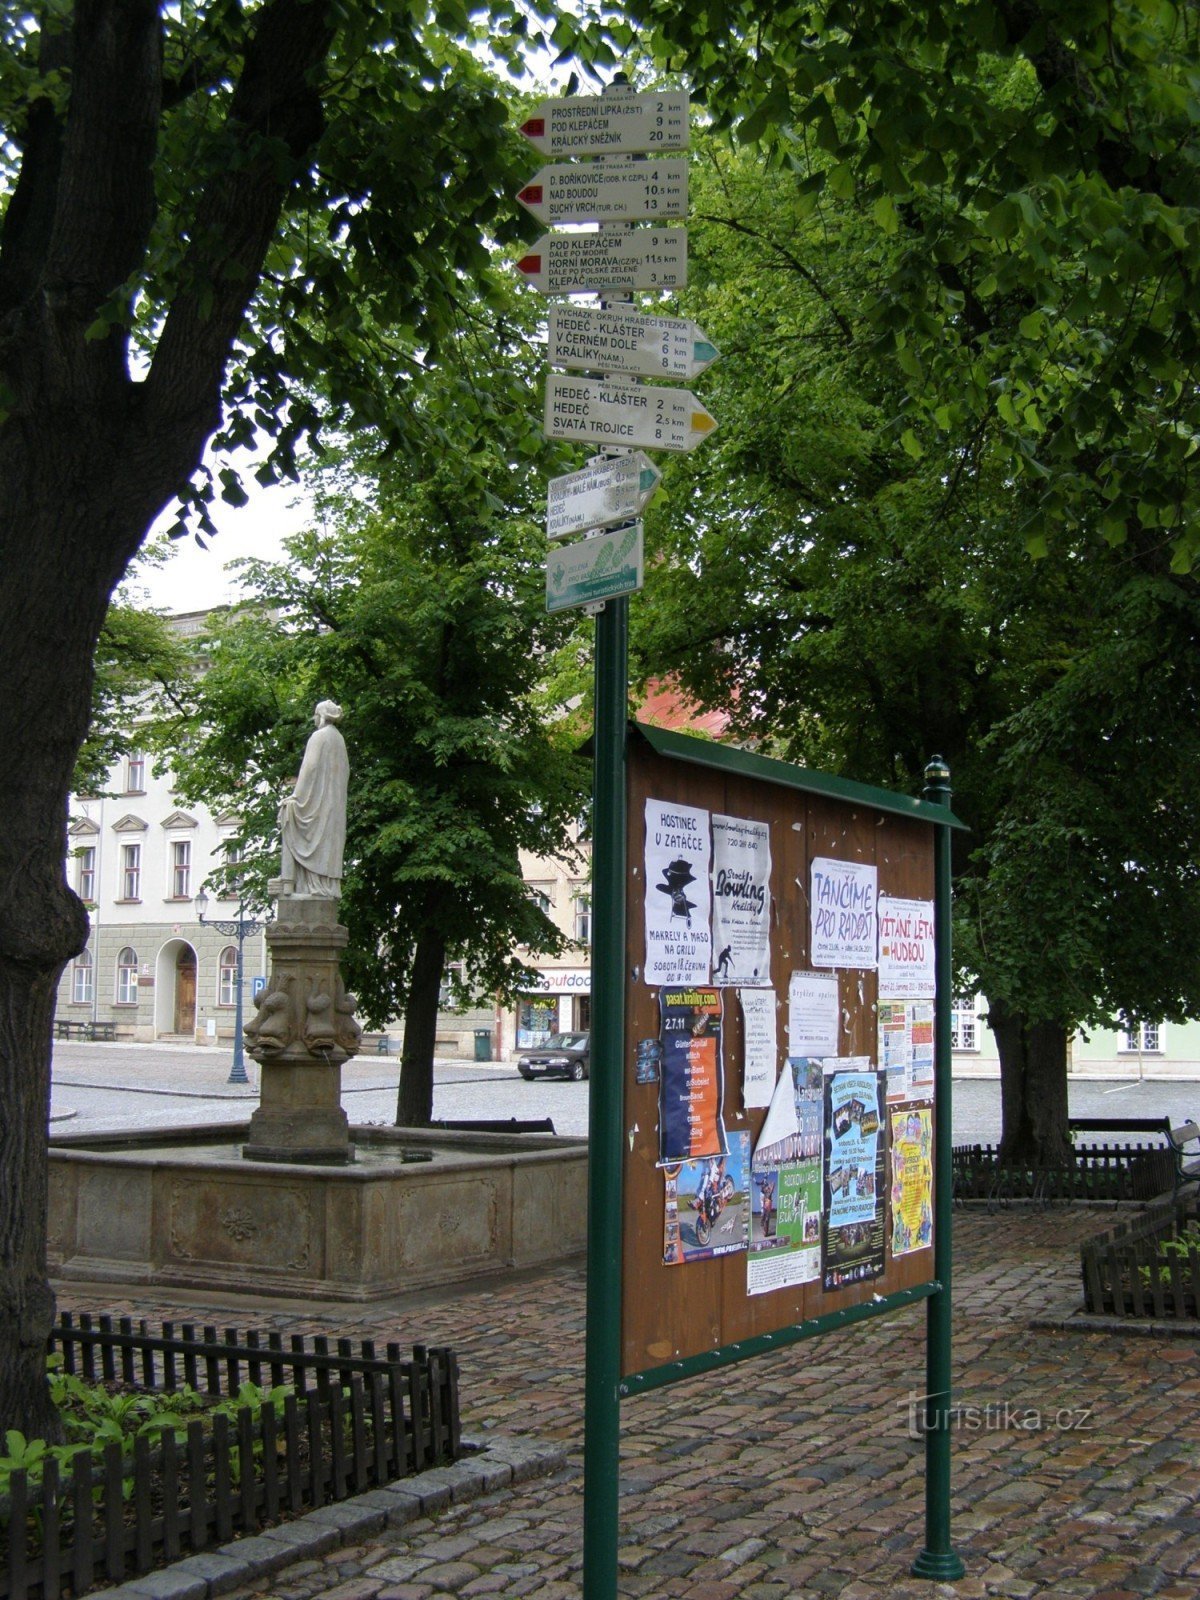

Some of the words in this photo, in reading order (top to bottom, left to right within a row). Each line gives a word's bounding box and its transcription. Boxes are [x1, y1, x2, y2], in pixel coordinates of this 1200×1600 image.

[552, 106, 599, 118] PROSTŘEDNÍ
[656, 103, 663, 112] 2
[668, 104, 681, 112] km
[552, 122, 566, 132] POD
[568, 118, 609, 131] KLEPÁČEM
[656, 117, 663, 126] 9
[668, 118, 681, 126] km
[552, 134, 589, 147] KRÁLICKÝ
[590, 132, 622, 145] SNĚŽNÍK
[650, 132, 663, 141] 20
[652, 172, 658, 180] 4
[667, 172, 680, 180] km
[550, 189, 566, 200] NAD
[567, 188, 598, 198] BOUDOU
[667, 186, 680, 194] km
[550, 202, 574, 214] SUCHÝ
[644, 200, 658, 210] 13
[666, 200, 680, 208] km
[550, 242, 569, 250] POD
[572, 238, 622, 250] KLEPÁČEM
[652, 238, 658, 246] 9
[550, 250, 568, 258] DÁLE
[582, 248, 608, 256] MODRÉ
[550, 257, 578, 268] HORNÍ
[549, 268, 568, 276] DÁLE
[549, 274, 584, 286] KLEPÁČ
[650, 274, 657, 282] 3
[596, 313, 622, 322] OKRUH
[659, 320, 688, 330] STEZKA
[556, 319, 590, 332] HEDEČ
[600, 323, 644, 338] KLÁŠTER
[662, 332, 670, 341] 2
[556, 332, 564, 342] V
[566, 331, 608, 347] ČERNÉM
[610, 338, 638, 350] DOLE
[662, 344, 669, 354] 6
[674, 348, 687, 356] km
[662, 358, 668, 368] 8
[674, 362, 686, 370] km
[554, 387, 590, 400] HEDEČ
[600, 392, 648, 408] KLÁŠTER
[657, 400, 664, 410] 2
[672, 404, 685, 412] km
[554, 402, 590, 416] HEDEČ
[672, 418, 684, 427] km
[553, 416, 587, 430] SVATÁ
[590, 421, 634, 436] TROJICE
[655, 429, 662, 438] 8
[672, 432, 684, 442] km
[660, 814, 698, 830] HOSTINEC
[665, 834, 702, 851] ZATÁČCE
[726, 868, 746, 881] Stock
[716, 869, 765, 915] Bowling
[815, 908, 836, 938] PRO
[838, 912, 872, 940] RADOST
[880, 912, 911, 938] VÍTÁNÍ
[914, 913, 934, 940] LÉTA
[650, 930, 681, 942] MAKRELY
[684, 932, 688, 942] A
[690, 932, 708, 943] MASO
[665, 944, 674, 954] NA
[676, 944, 696, 956] GRILU
[891, 942, 924, 962] HUDBOU
[654, 962, 677, 971] SOBOTA
[256, 980, 264, 996] P
[666, 992, 717, 1007] pasat.kraliky.com
[665, 1018, 684, 1030] 2.7.11
